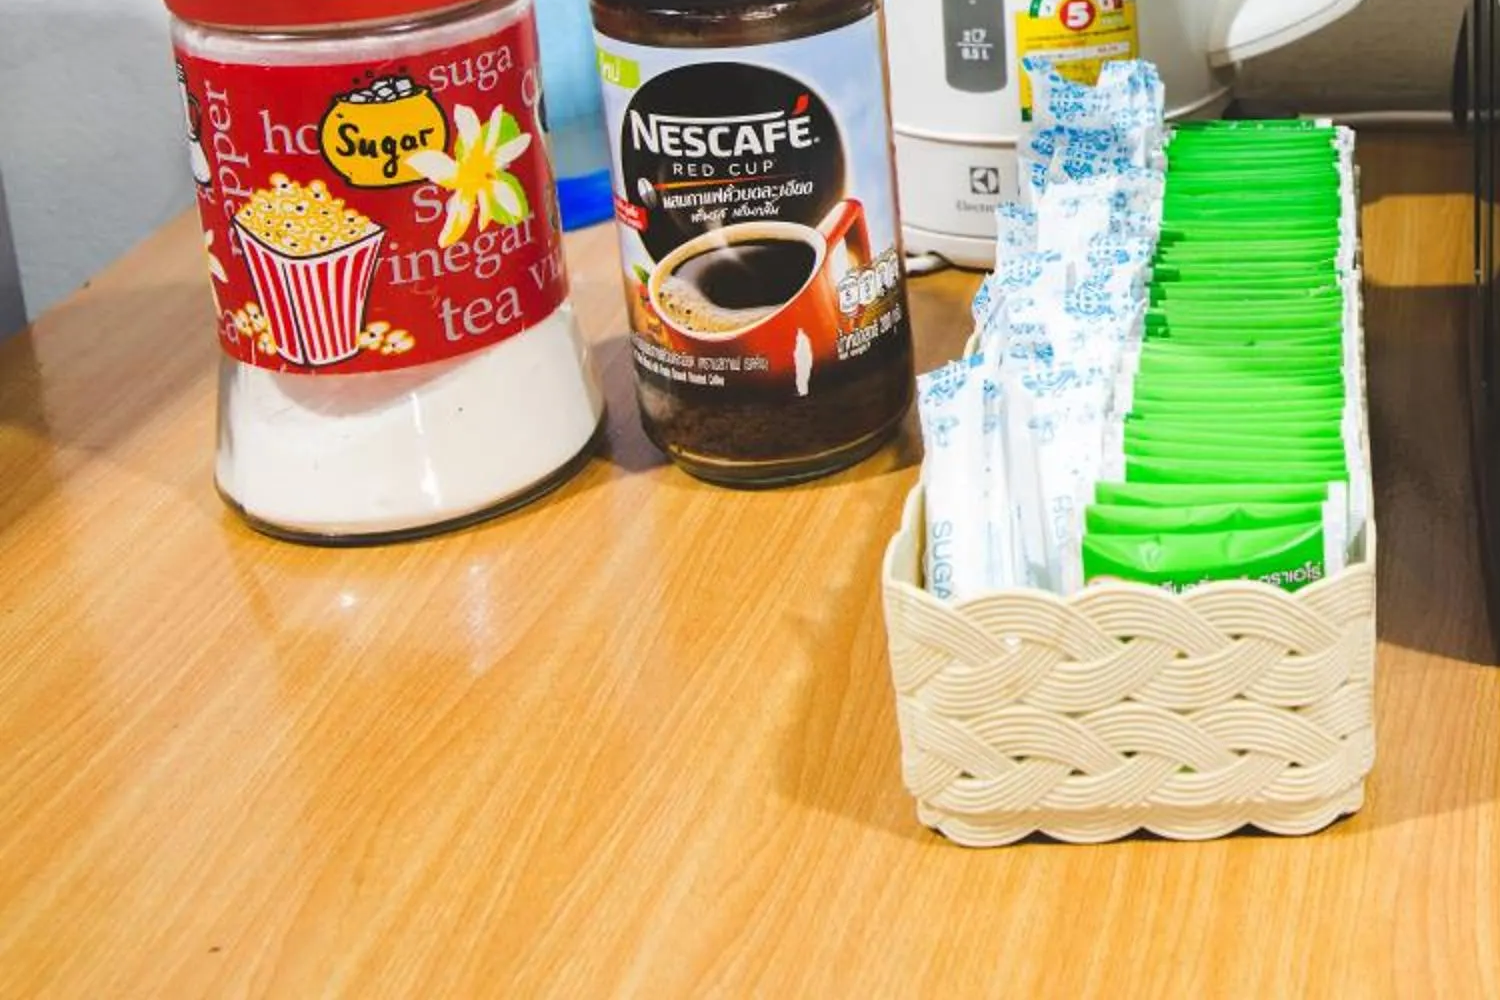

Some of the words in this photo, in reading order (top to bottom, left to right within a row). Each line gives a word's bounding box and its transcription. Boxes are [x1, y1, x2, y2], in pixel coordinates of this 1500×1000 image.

[1066, 1, 1091, 28] 5
[335, 122, 435, 179] Sugar
[630, 94, 812, 158] NESCAFÉ
[673, 162, 715, 177] RED
[729, 158, 774, 176] CUP
[384, 212, 537, 287] inegar
[438, 285, 524, 343] tea
